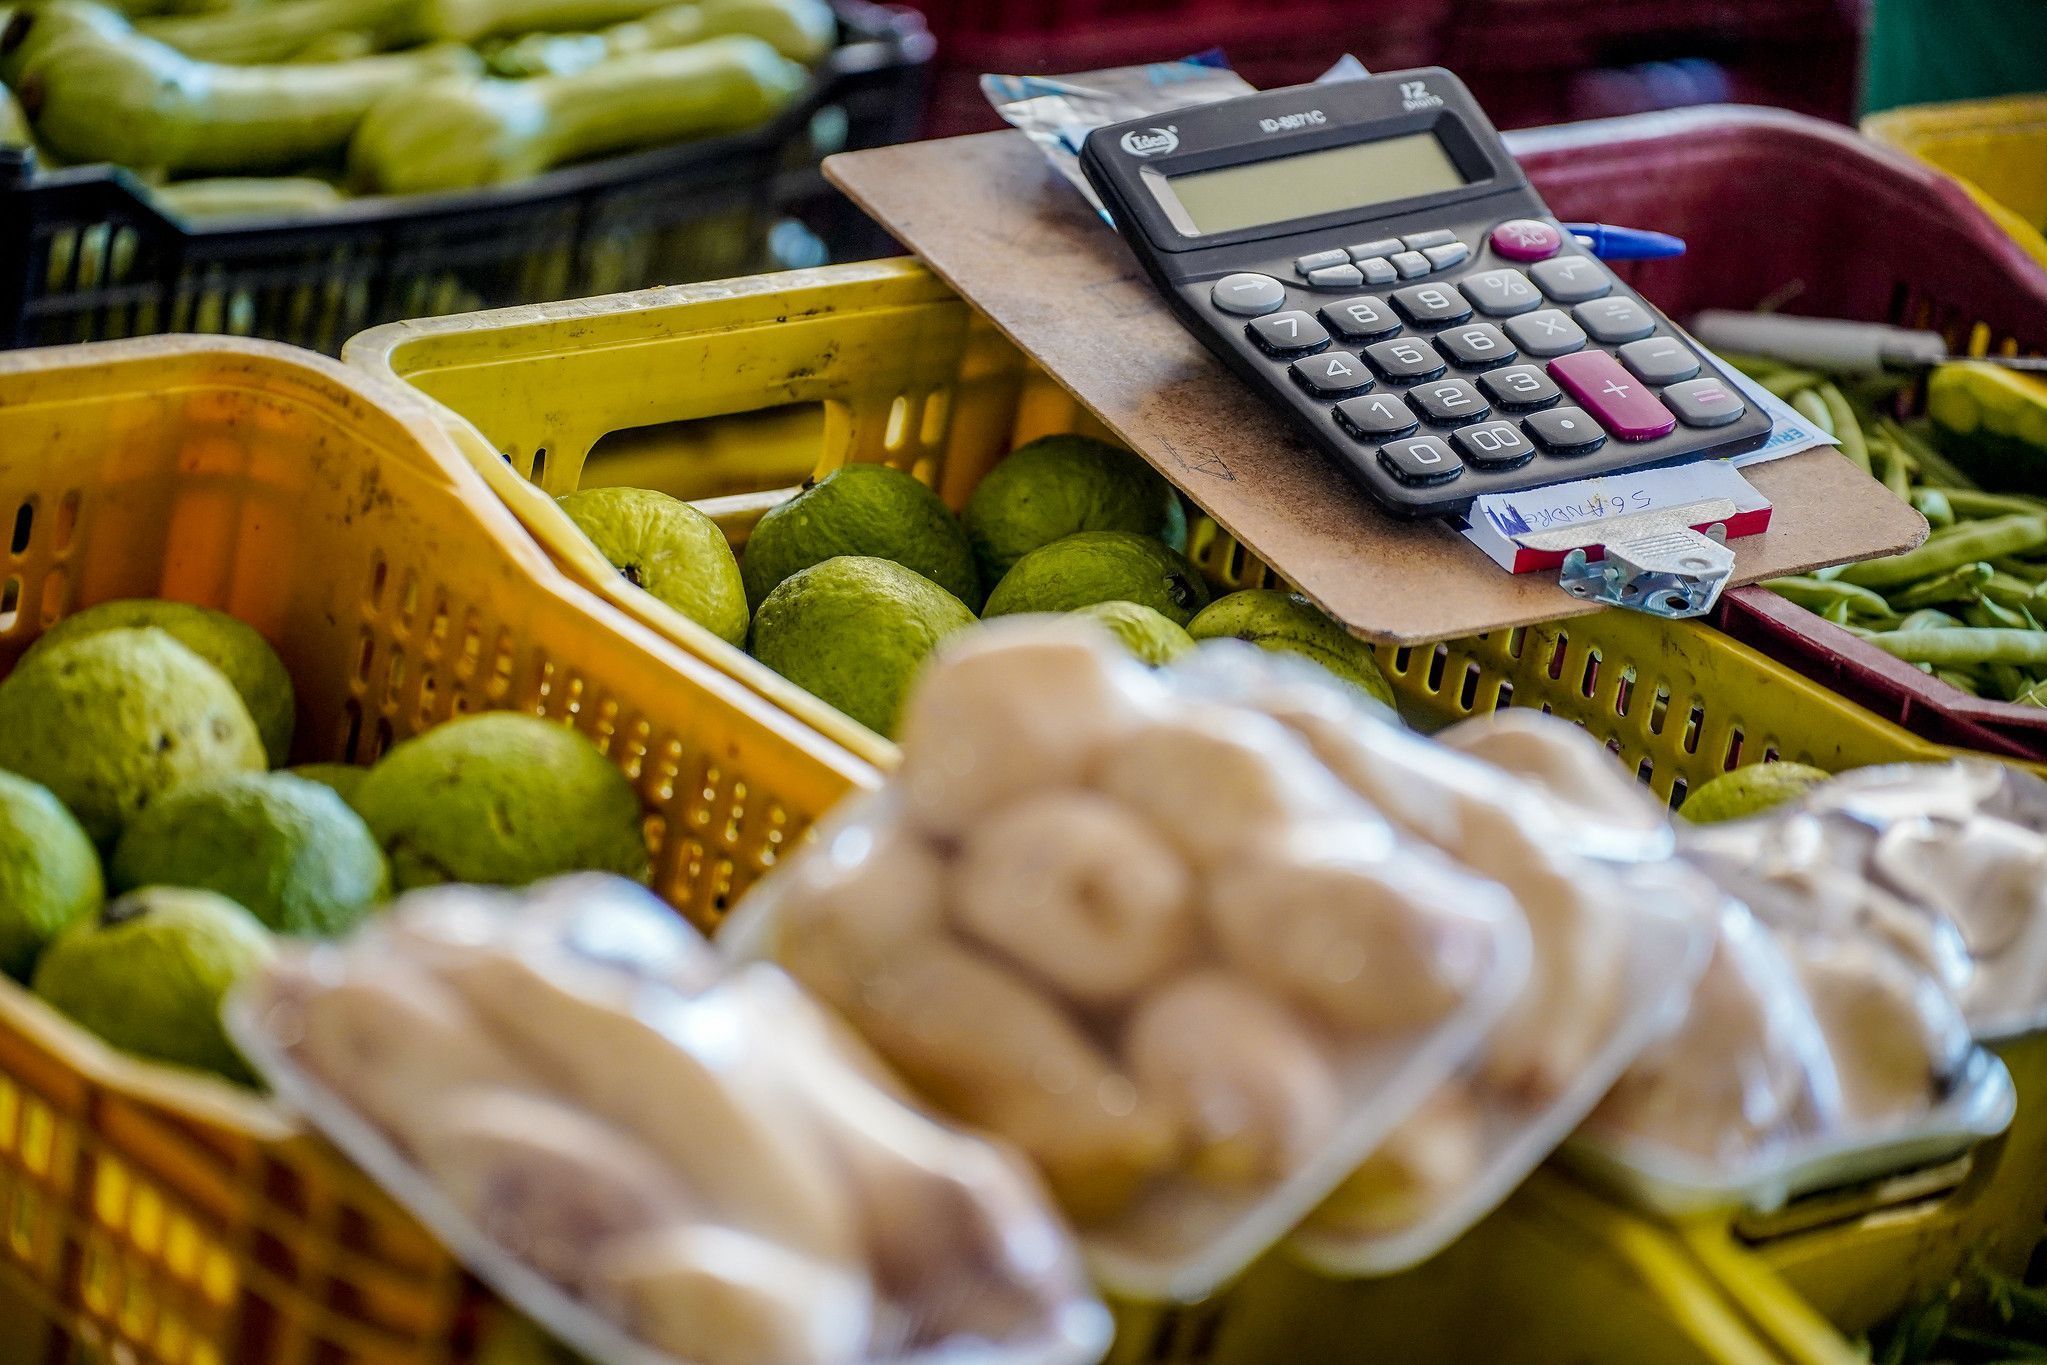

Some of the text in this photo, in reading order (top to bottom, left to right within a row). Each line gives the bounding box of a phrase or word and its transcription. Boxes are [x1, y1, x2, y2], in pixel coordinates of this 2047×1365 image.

[1399, 81, 1430, 100] 12
[1273, 317, 1298, 337] 7
[1347, 304, 1379, 323] 8
[1417, 290, 1450, 309] 9
[1326, 359, 1352, 377] 4
[1391, 345, 1424, 364] 5
[1463, 331, 1495, 350] 6
[1371, 401, 1394, 419] 1
[1434, 387, 1471, 407] 2
[1506, 372, 1541, 392] 3
[1408, 444, 1442, 464] 0
[1471, 427, 1521, 451] 00
